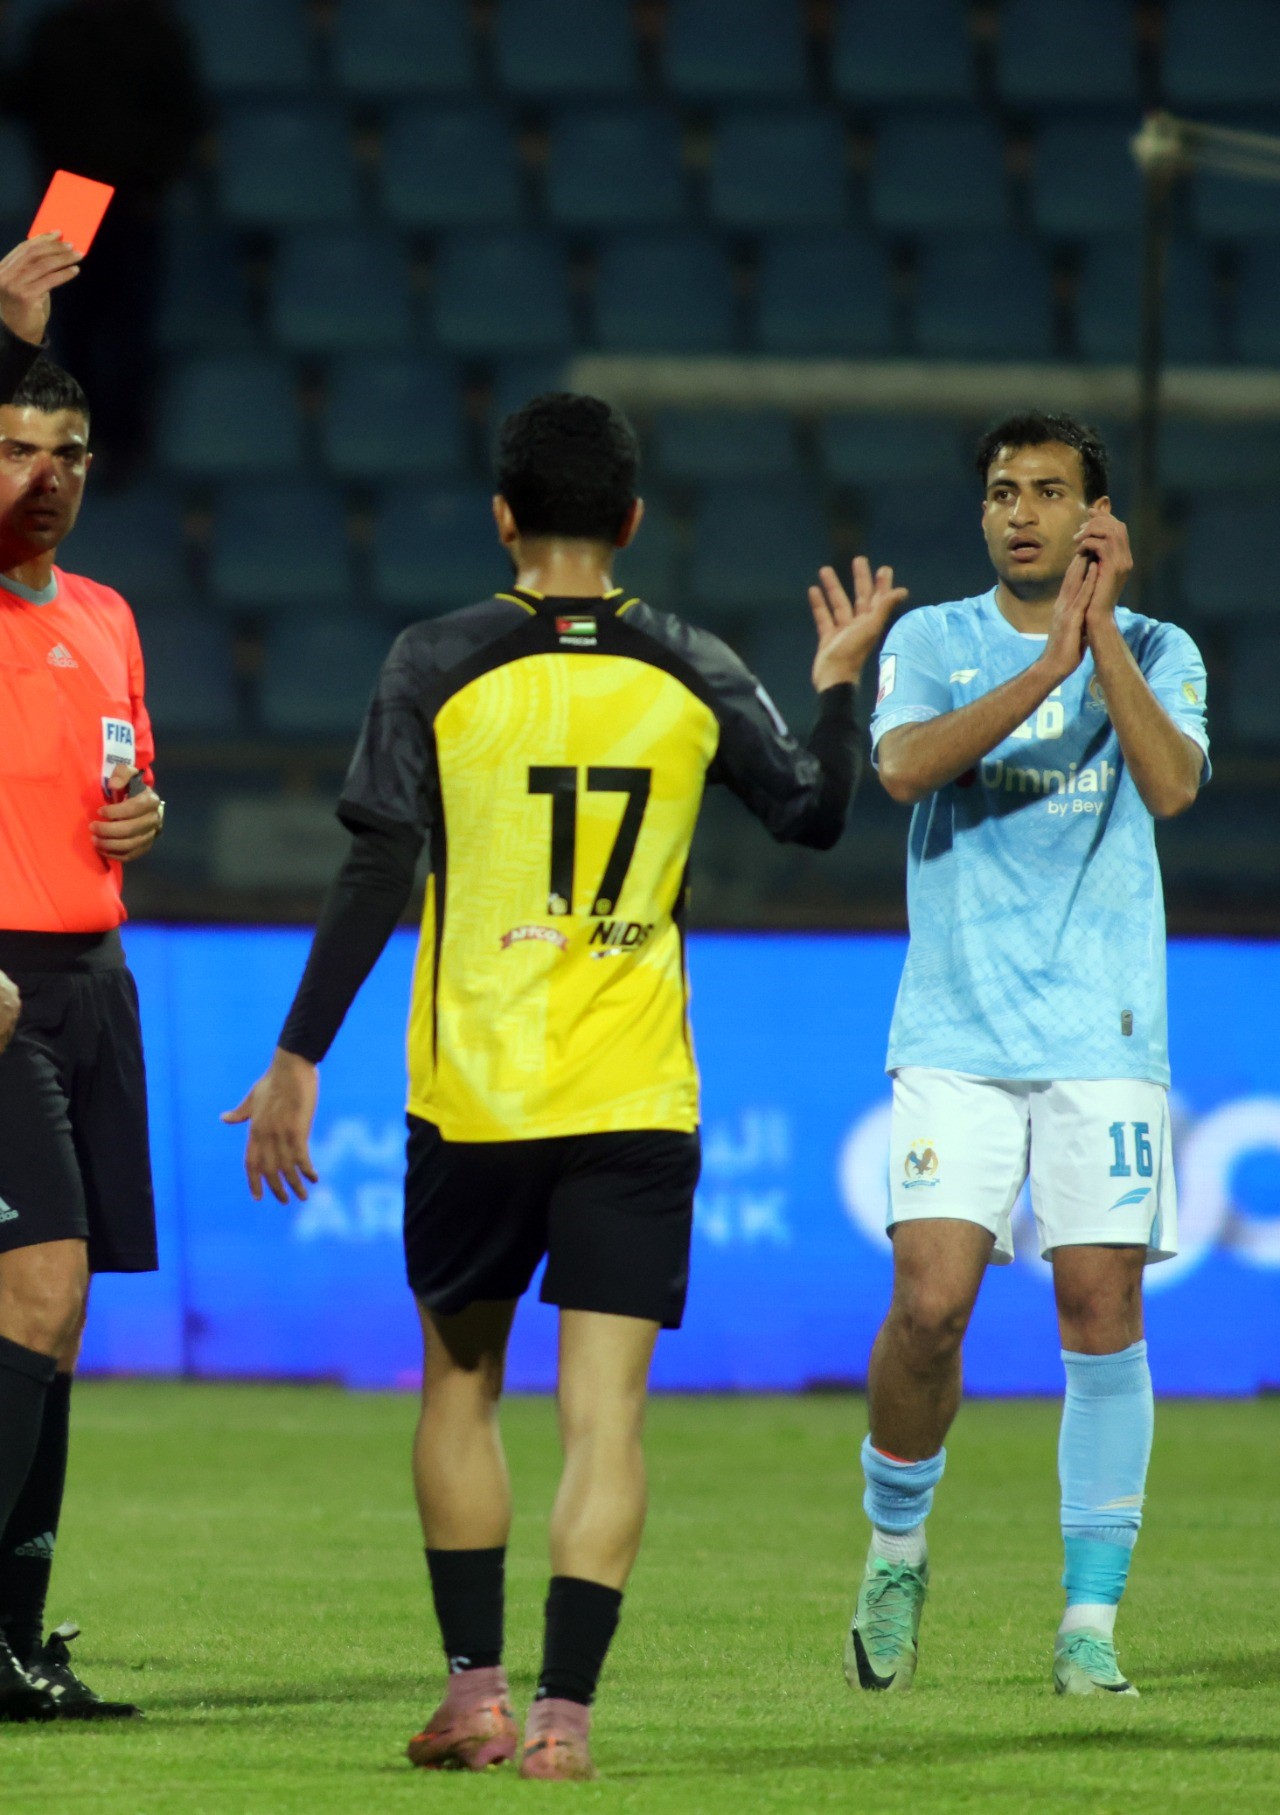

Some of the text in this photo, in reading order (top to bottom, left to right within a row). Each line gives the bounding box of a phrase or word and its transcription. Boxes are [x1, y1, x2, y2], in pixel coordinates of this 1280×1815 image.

[107, 723, 132, 745] FIFA
[1010, 685, 1064, 740] 6
[1047, 799, 1104, 816] by Bey
[528, 765, 652, 916] 17
[1109, 1121, 1153, 1178] 16
